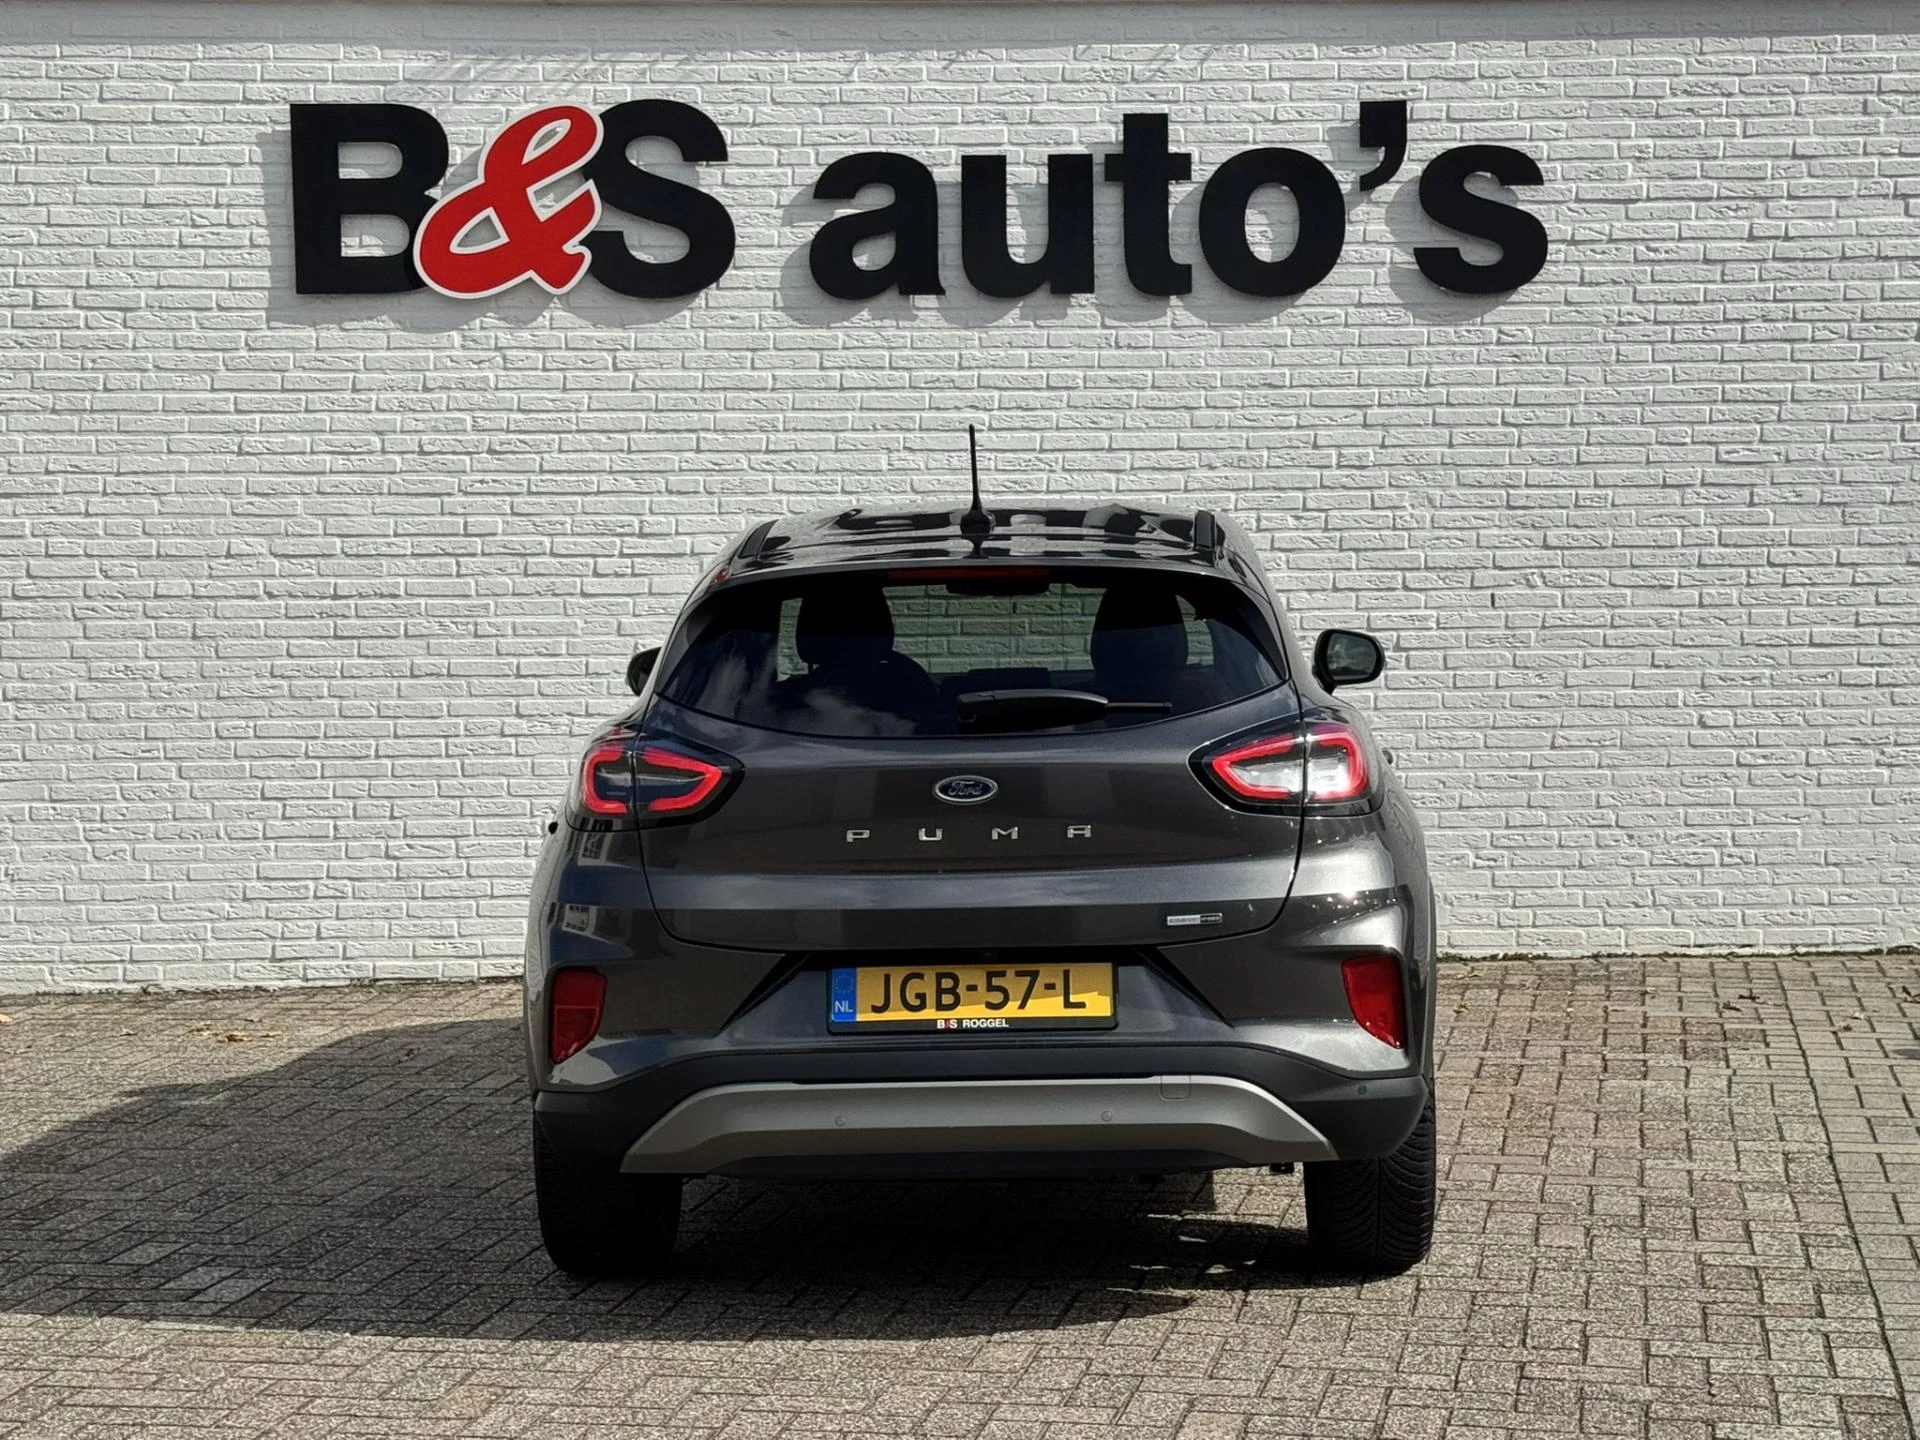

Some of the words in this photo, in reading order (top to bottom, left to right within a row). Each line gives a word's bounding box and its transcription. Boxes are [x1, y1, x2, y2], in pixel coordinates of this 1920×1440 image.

[290, 99, 736, 300] B&S
[808, 100, 1550, 300] auto's
[948, 779, 983, 797] Ford
[846, 824, 1092, 843] PUMA
[870, 969, 1087, 1015] JGB-57-L
[834, 1001, 854, 1014] NL
[962, 1018, 1010, 1029] ROGGEL
